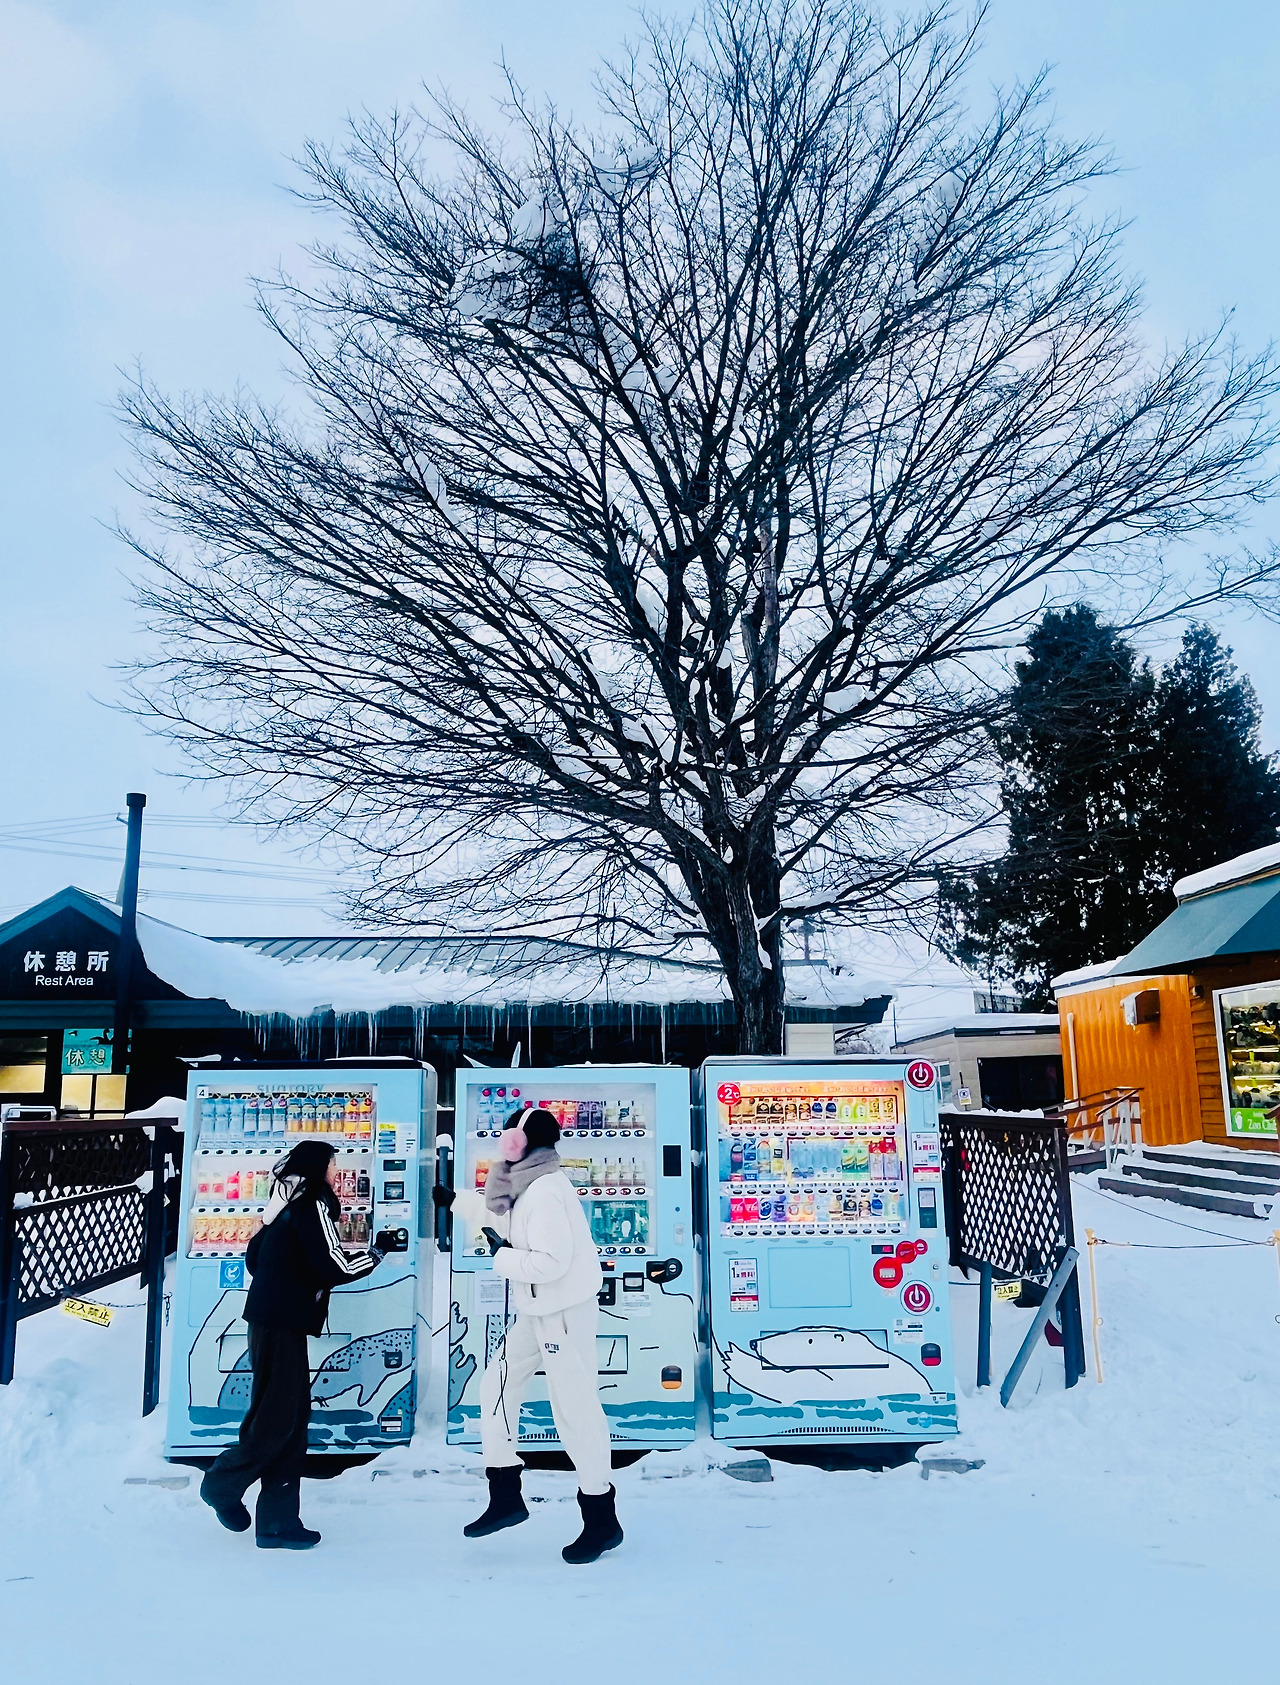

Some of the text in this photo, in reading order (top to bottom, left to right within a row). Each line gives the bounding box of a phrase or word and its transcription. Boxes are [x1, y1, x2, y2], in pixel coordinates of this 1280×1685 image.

[24, 950, 110, 973] 休憩所
[35, 975, 94, 986] Rest Area
[198, 1089, 205, 1097] 4
